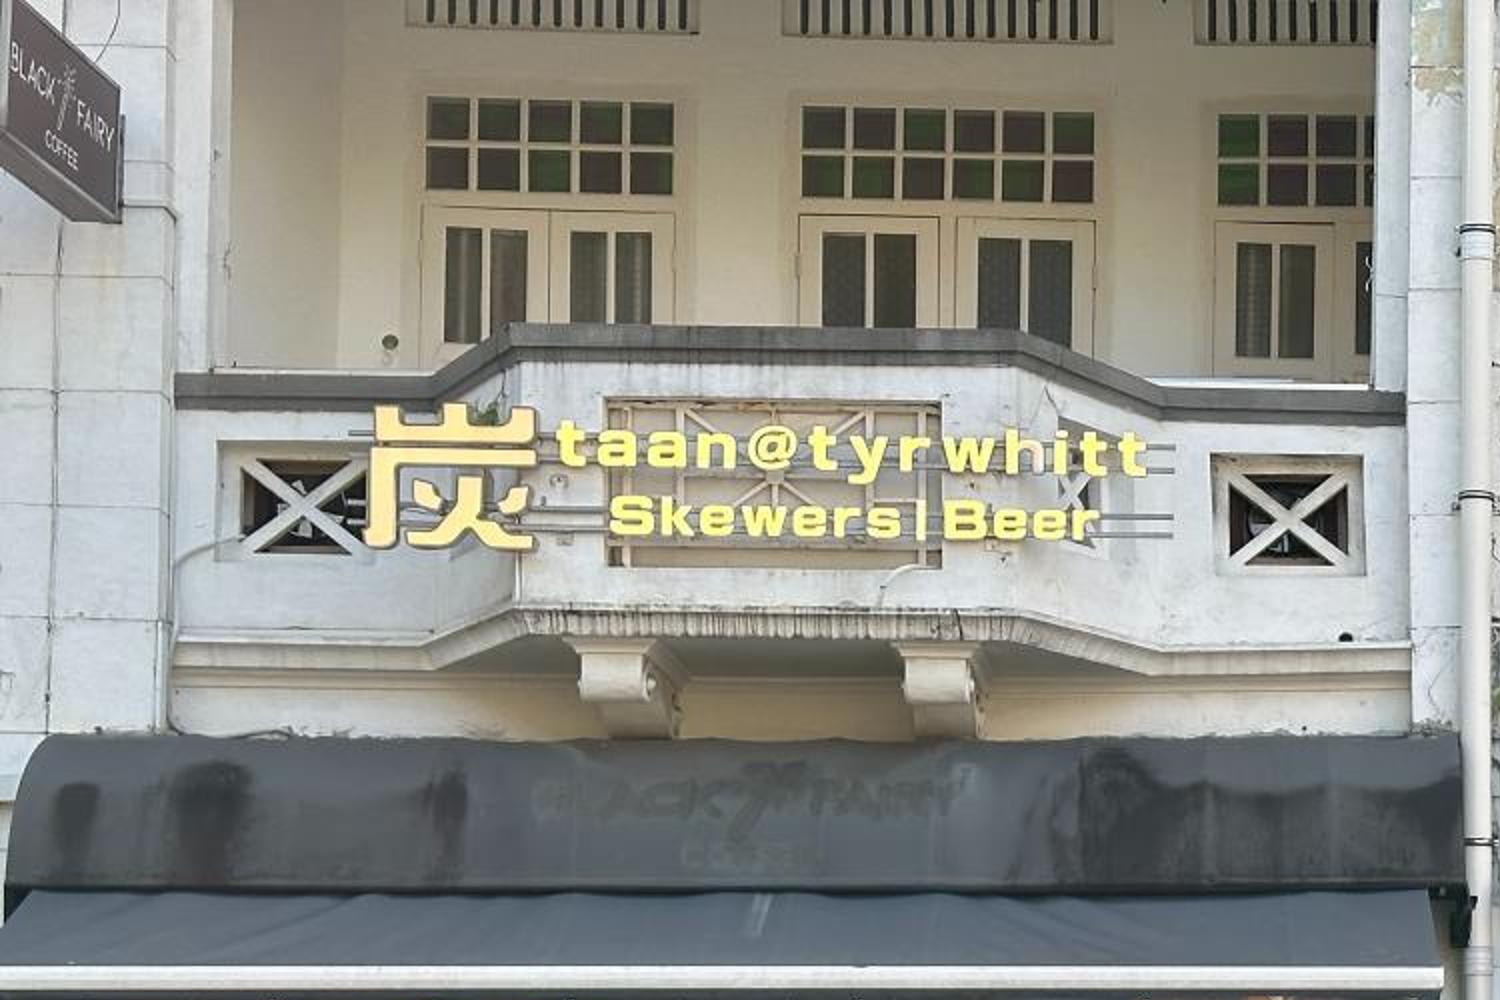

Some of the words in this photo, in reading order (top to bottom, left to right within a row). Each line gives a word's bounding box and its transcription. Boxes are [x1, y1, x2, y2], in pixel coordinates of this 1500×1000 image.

[10, 41, 55, 105] BLACK
[77, 100, 115, 152] FAIRY
[45, 129, 79, 171] COFFEE
[363, 402, 538, 550] 炭
[556, 418, 1148, 484] taan@tyrwhitt
[609, 494, 901, 539] Skewers
[943, 498, 1101, 543] Beer
